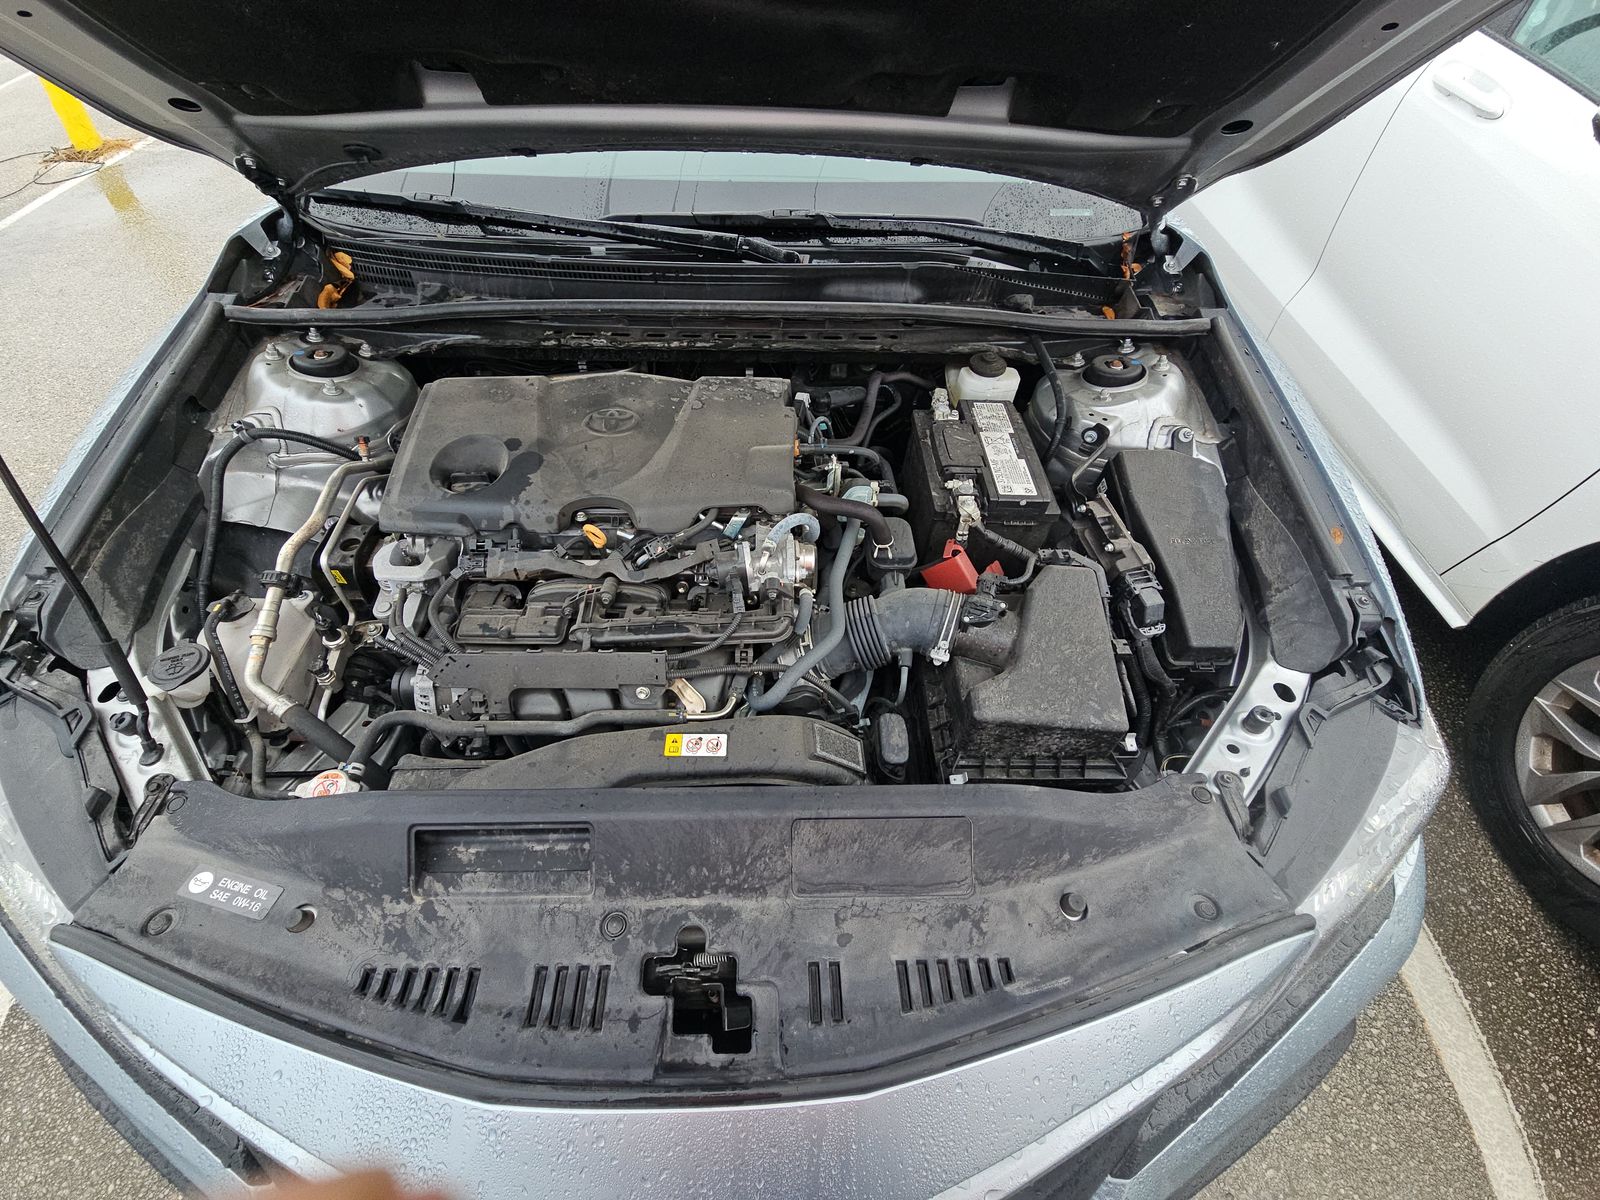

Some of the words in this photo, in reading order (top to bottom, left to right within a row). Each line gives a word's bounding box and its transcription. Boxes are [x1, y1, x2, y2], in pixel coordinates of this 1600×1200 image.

[218, 877, 252, 894] ENGINE
[254, 888, 269, 900] OIL
[209, 889, 230, 902] SAE
[232, 896, 261, 912] 0W-16
